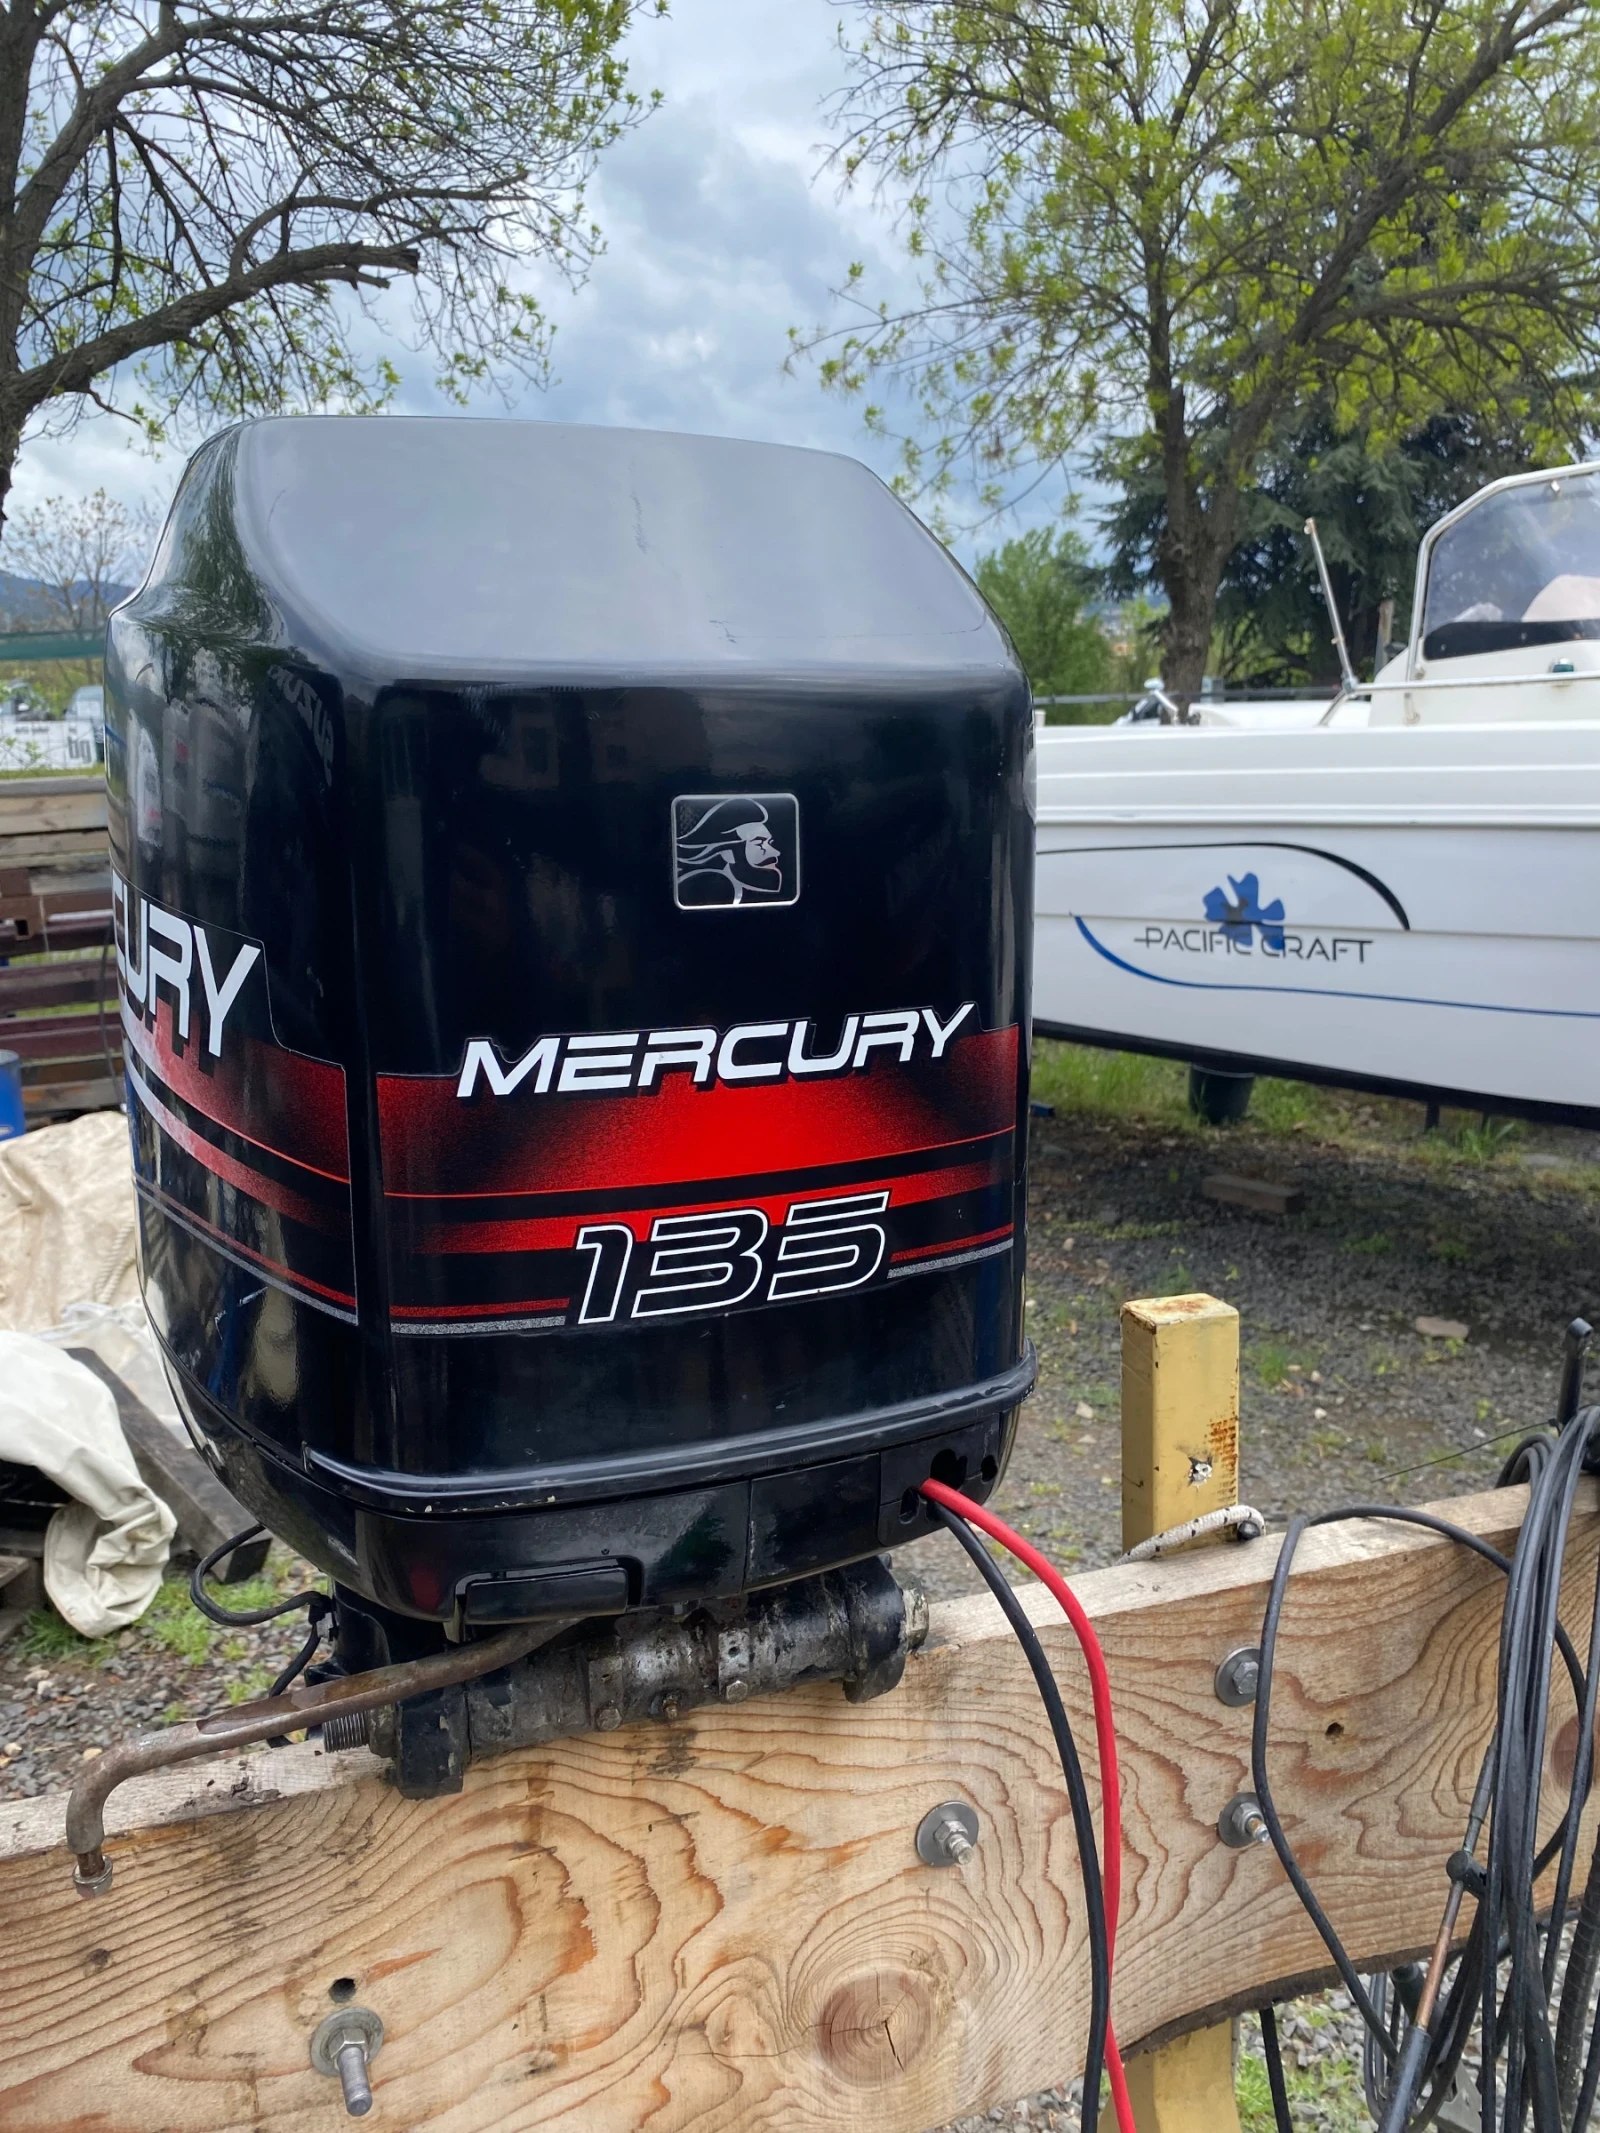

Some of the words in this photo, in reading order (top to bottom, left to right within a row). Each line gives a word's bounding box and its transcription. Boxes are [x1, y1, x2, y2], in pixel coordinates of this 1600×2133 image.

[1134, 926, 1253, 956] PACIFIC
[1260, 934, 1374, 964] CRAFT
[456, 1003, 975, 1098] MERCURY
[576, 1191, 891, 1325] 135
